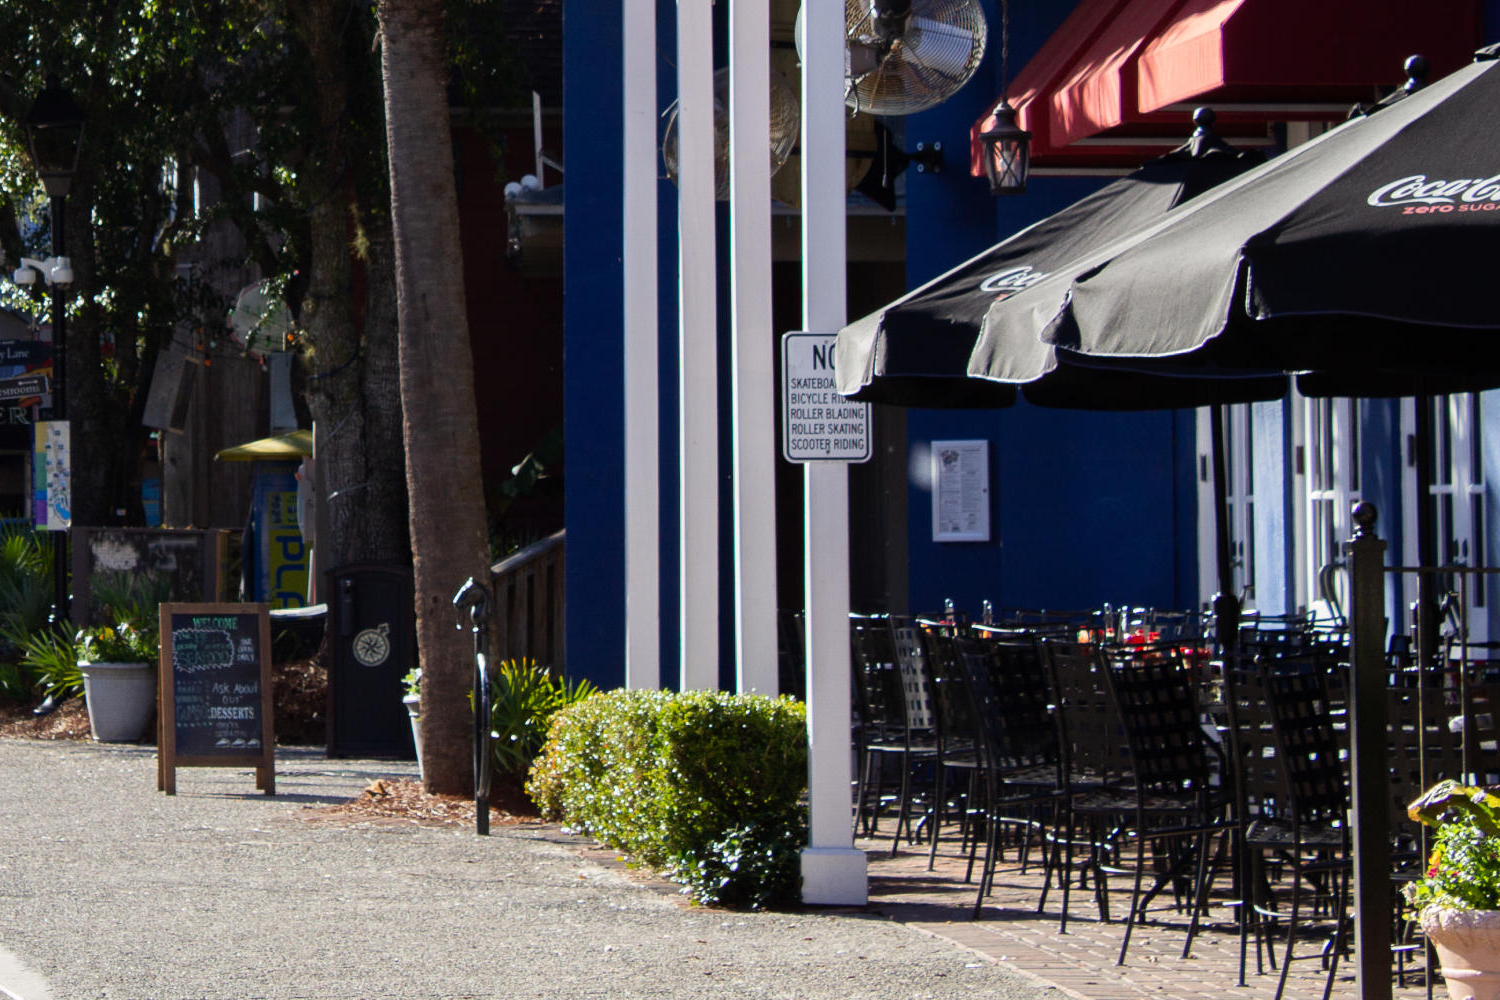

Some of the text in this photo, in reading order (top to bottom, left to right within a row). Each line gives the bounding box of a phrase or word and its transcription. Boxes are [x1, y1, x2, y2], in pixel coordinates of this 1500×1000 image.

[1402, 203, 1500, 215] zero SUG
[791, 378, 837, 389] SKATEBOA
[791, 393, 828, 404] BICYCLE
[791, 408, 864, 420] ROLLER BLADING
[792, 423, 864, 435] ROLLER SKATING
[791, 438, 864, 450] SCOOTER RIDING
[192, 616, 238, 630] WELCOME
[210, 706, 255, 720] DESSERTS
